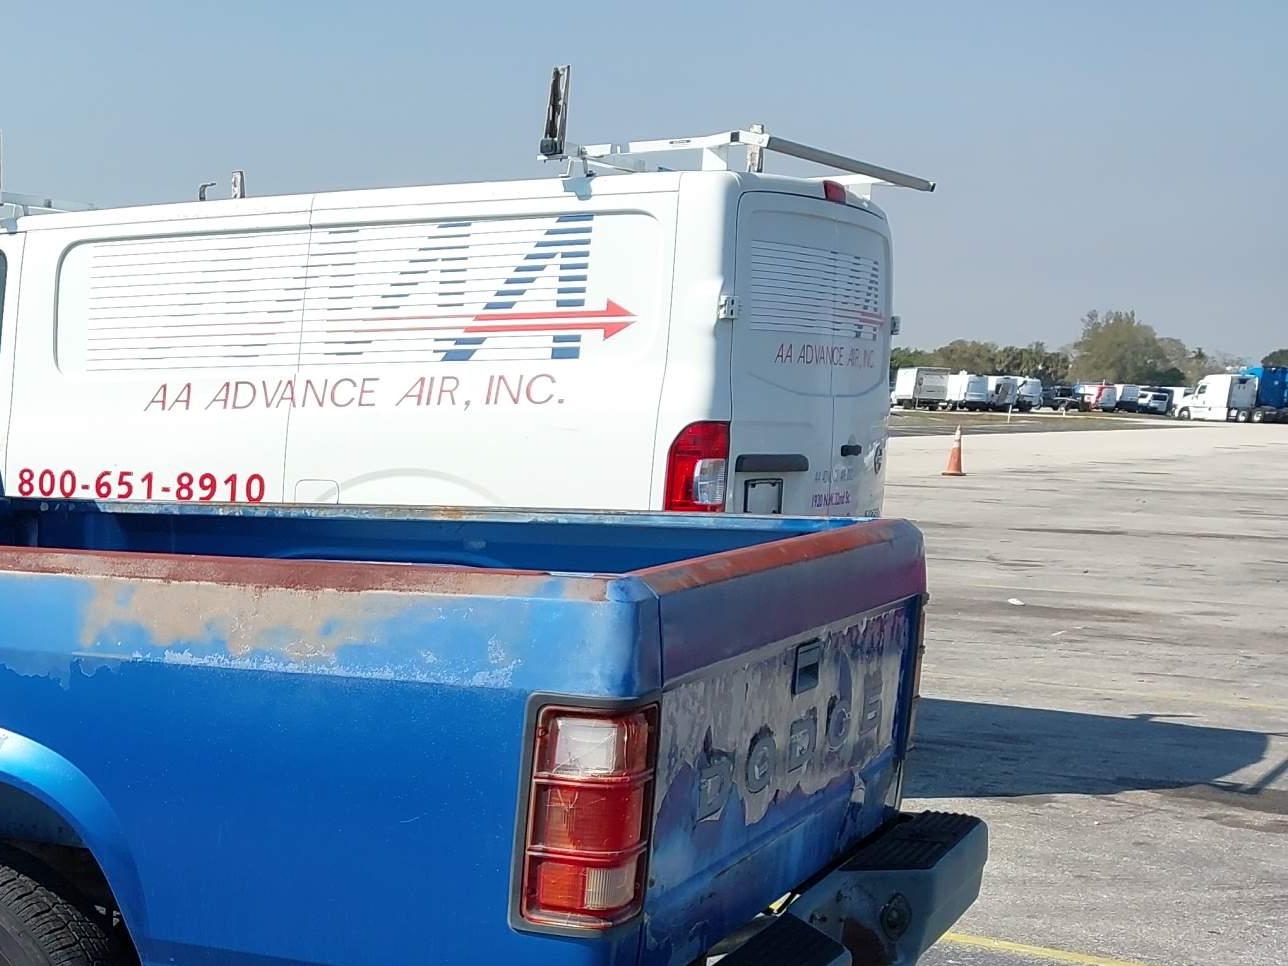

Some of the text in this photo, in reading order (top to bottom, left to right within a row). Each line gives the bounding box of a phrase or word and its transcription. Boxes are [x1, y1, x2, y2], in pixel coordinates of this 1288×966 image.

[774, 343, 793, 363] AA
[797, 343, 845, 366] ADVANCE
[143, 373, 564, 411] AA ADVANCE AIR, INC.
[17, 468, 265, 503] 800-651-8910
[696, 669, 883, 823] DODGE
